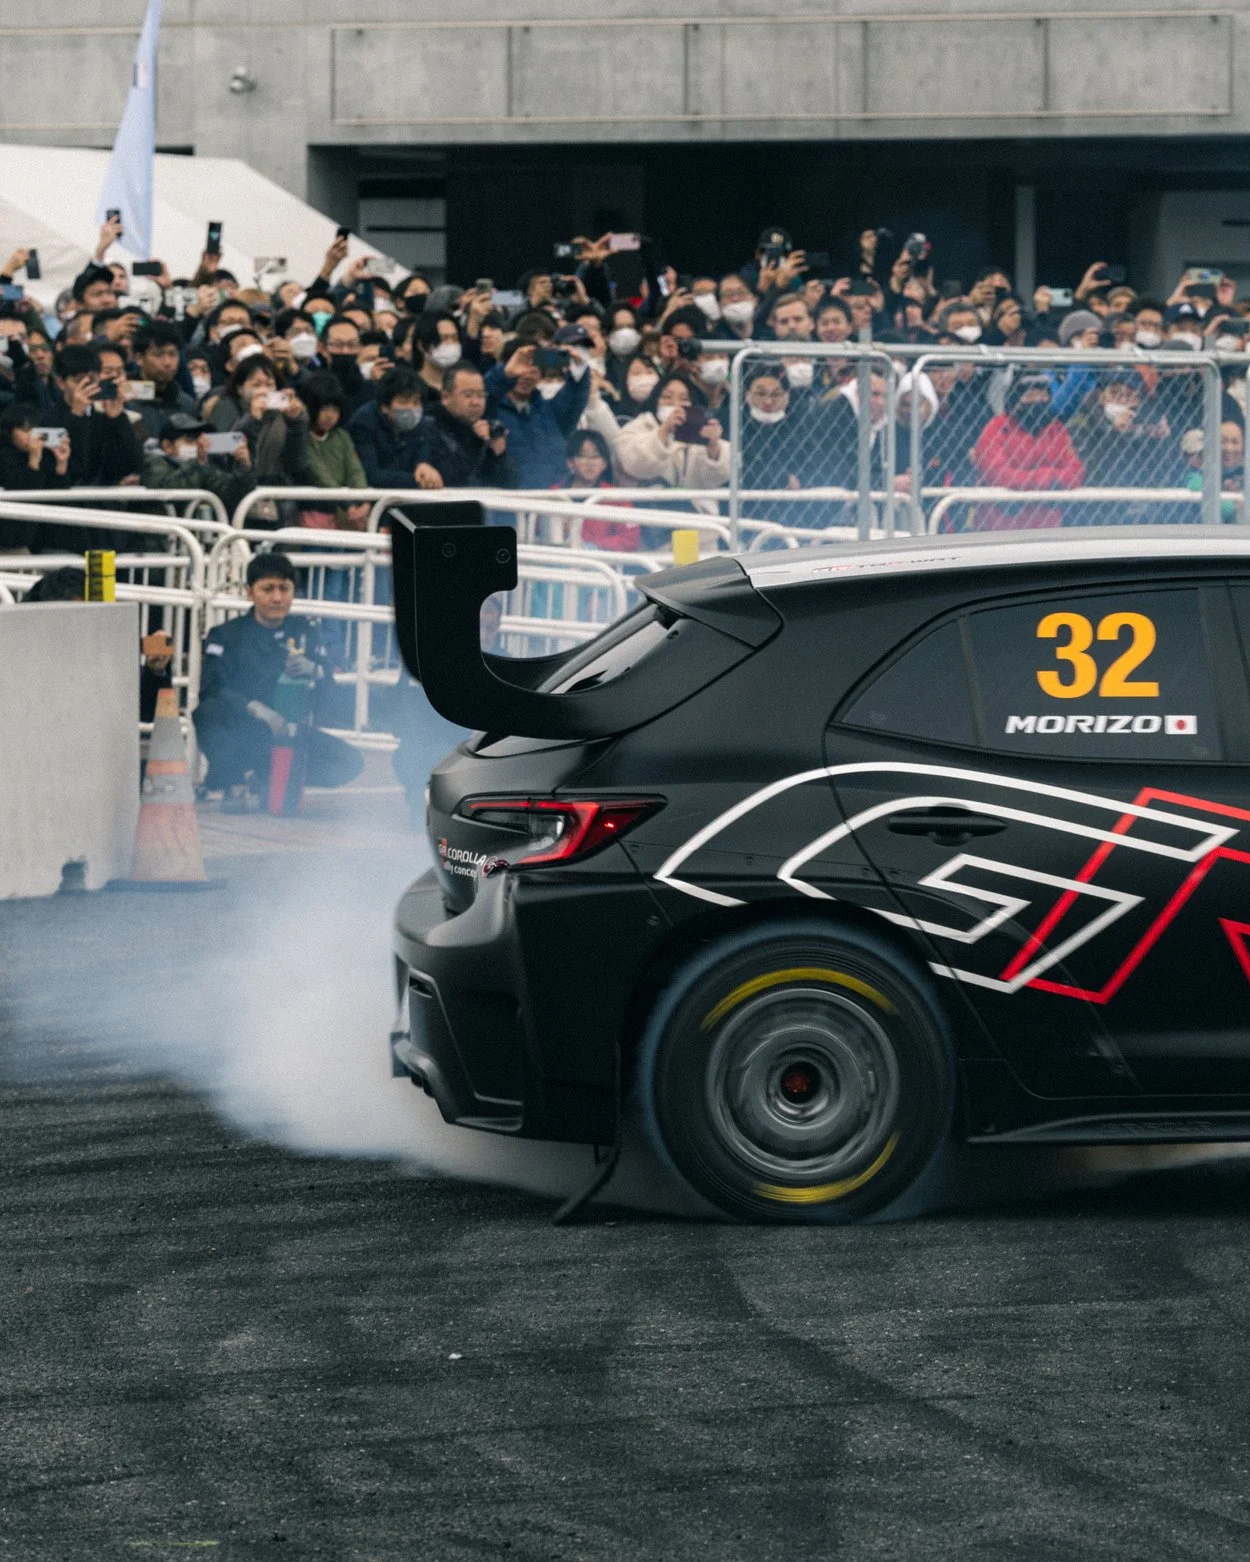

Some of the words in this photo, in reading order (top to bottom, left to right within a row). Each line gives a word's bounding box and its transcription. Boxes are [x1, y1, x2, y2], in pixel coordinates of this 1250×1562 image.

[1036, 612, 1159, 699] 32
[1005, 715, 1162, 734] MORIZO
[447, 847, 487, 866] COROLLA
